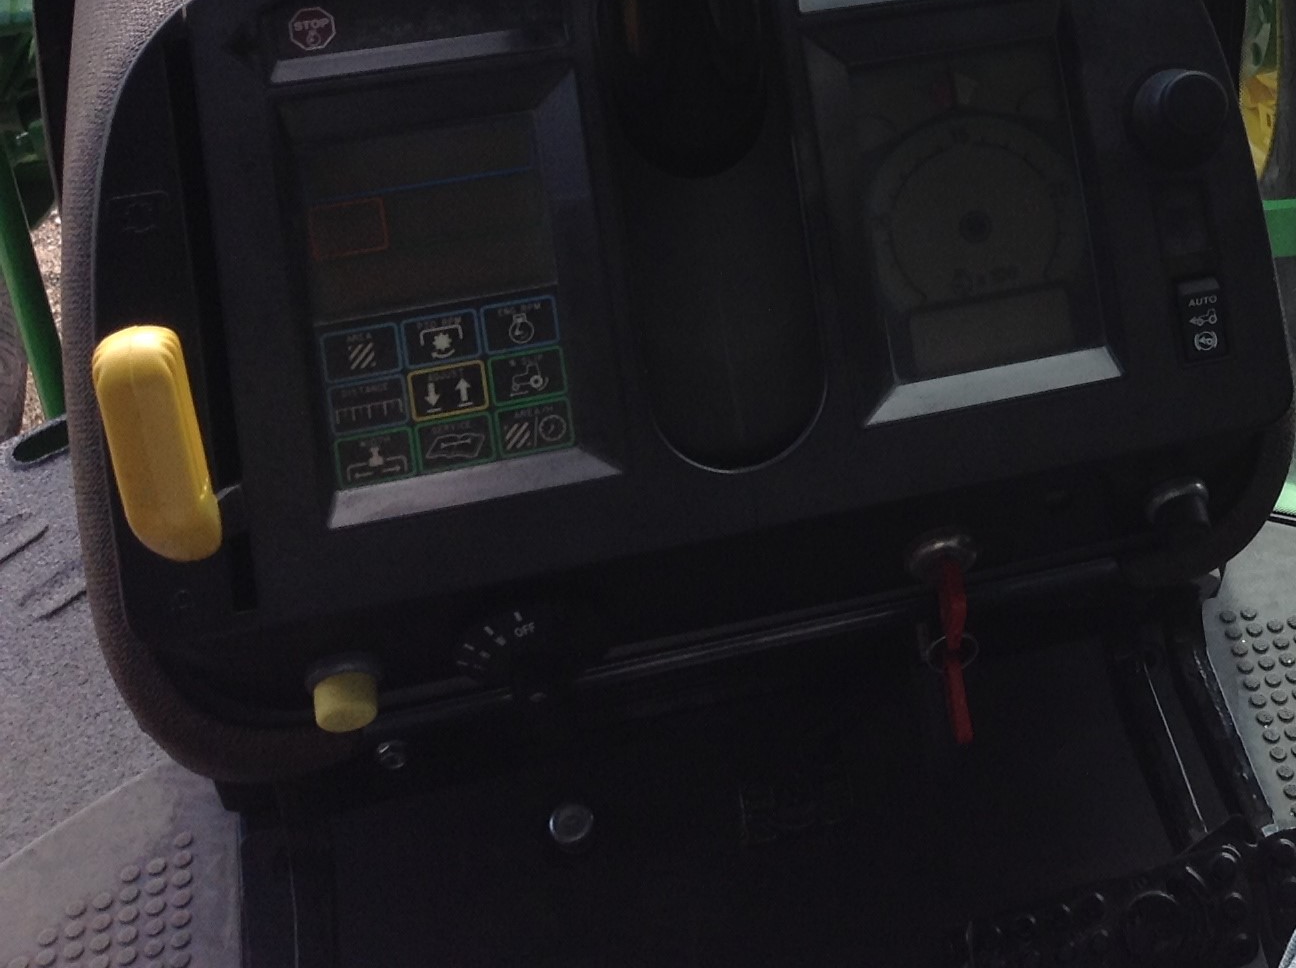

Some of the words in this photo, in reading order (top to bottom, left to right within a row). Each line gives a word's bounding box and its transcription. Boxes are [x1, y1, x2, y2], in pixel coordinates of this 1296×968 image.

[293, 18, 330, 32] STOP
[1187, 293, 1218, 308] AUTO
[513, 620, 536, 639] OFF
